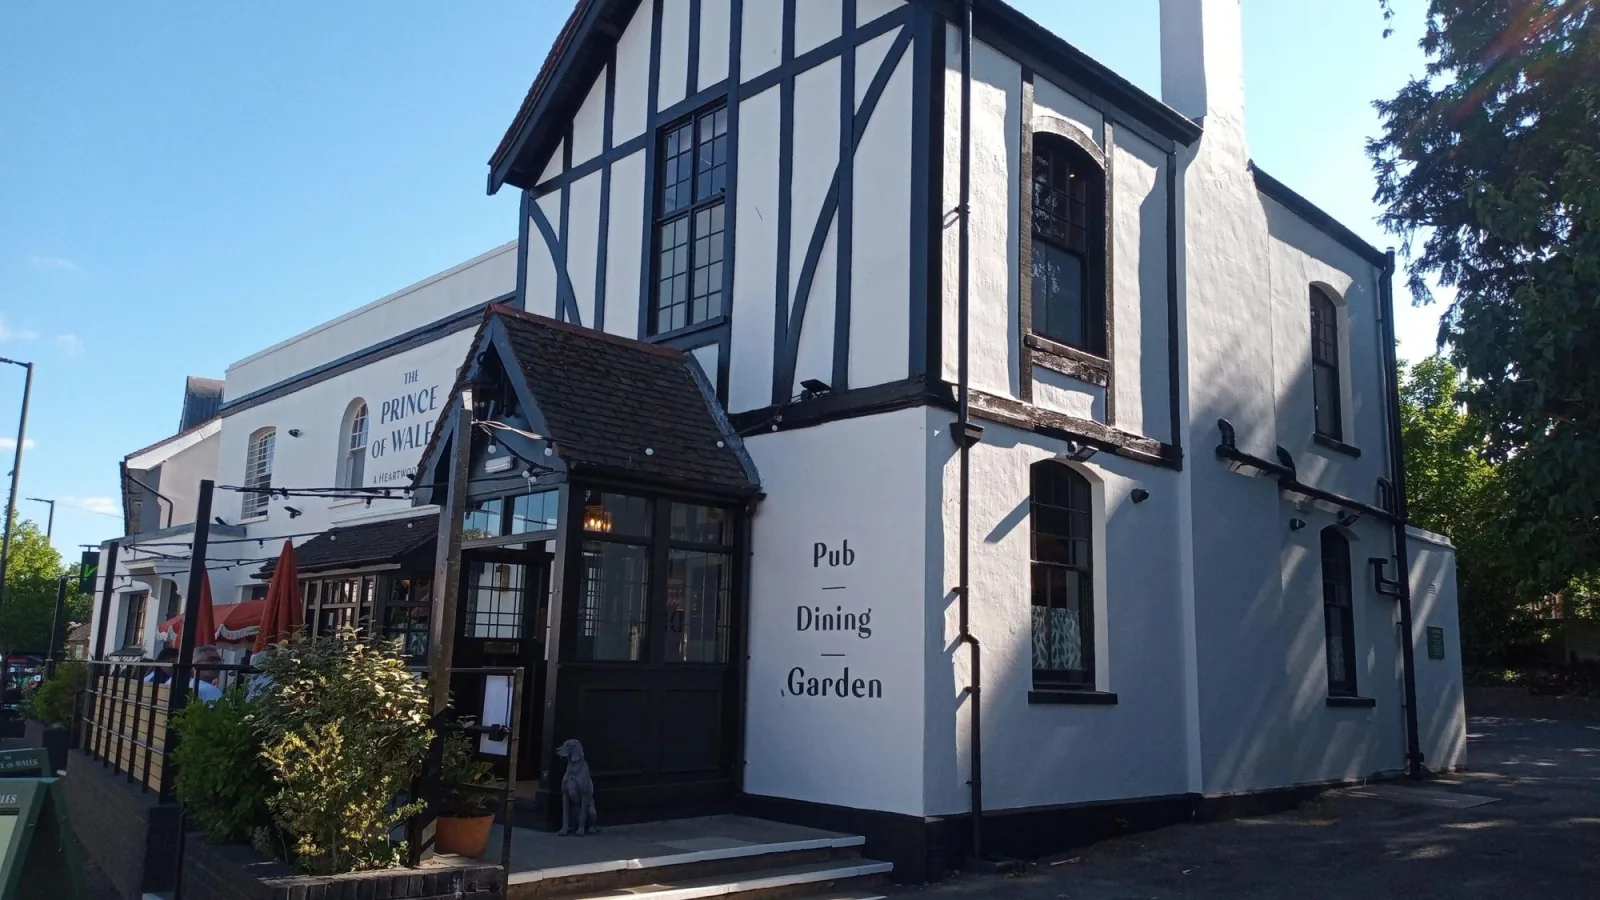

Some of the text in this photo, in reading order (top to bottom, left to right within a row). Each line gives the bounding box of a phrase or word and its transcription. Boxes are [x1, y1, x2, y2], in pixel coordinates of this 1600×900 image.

[404, 369, 419, 385] THE
[381, 385, 439, 425] PRINCE
[371, 420, 434, 459] OF WALE
[378, 466, 417, 484] HEARTWOO
[813, 539, 855, 568] Pub
[796, 605, 872, 639] Dining
[787, 666, 882, 698] Garden
[0, 794, 17, 804] LES
